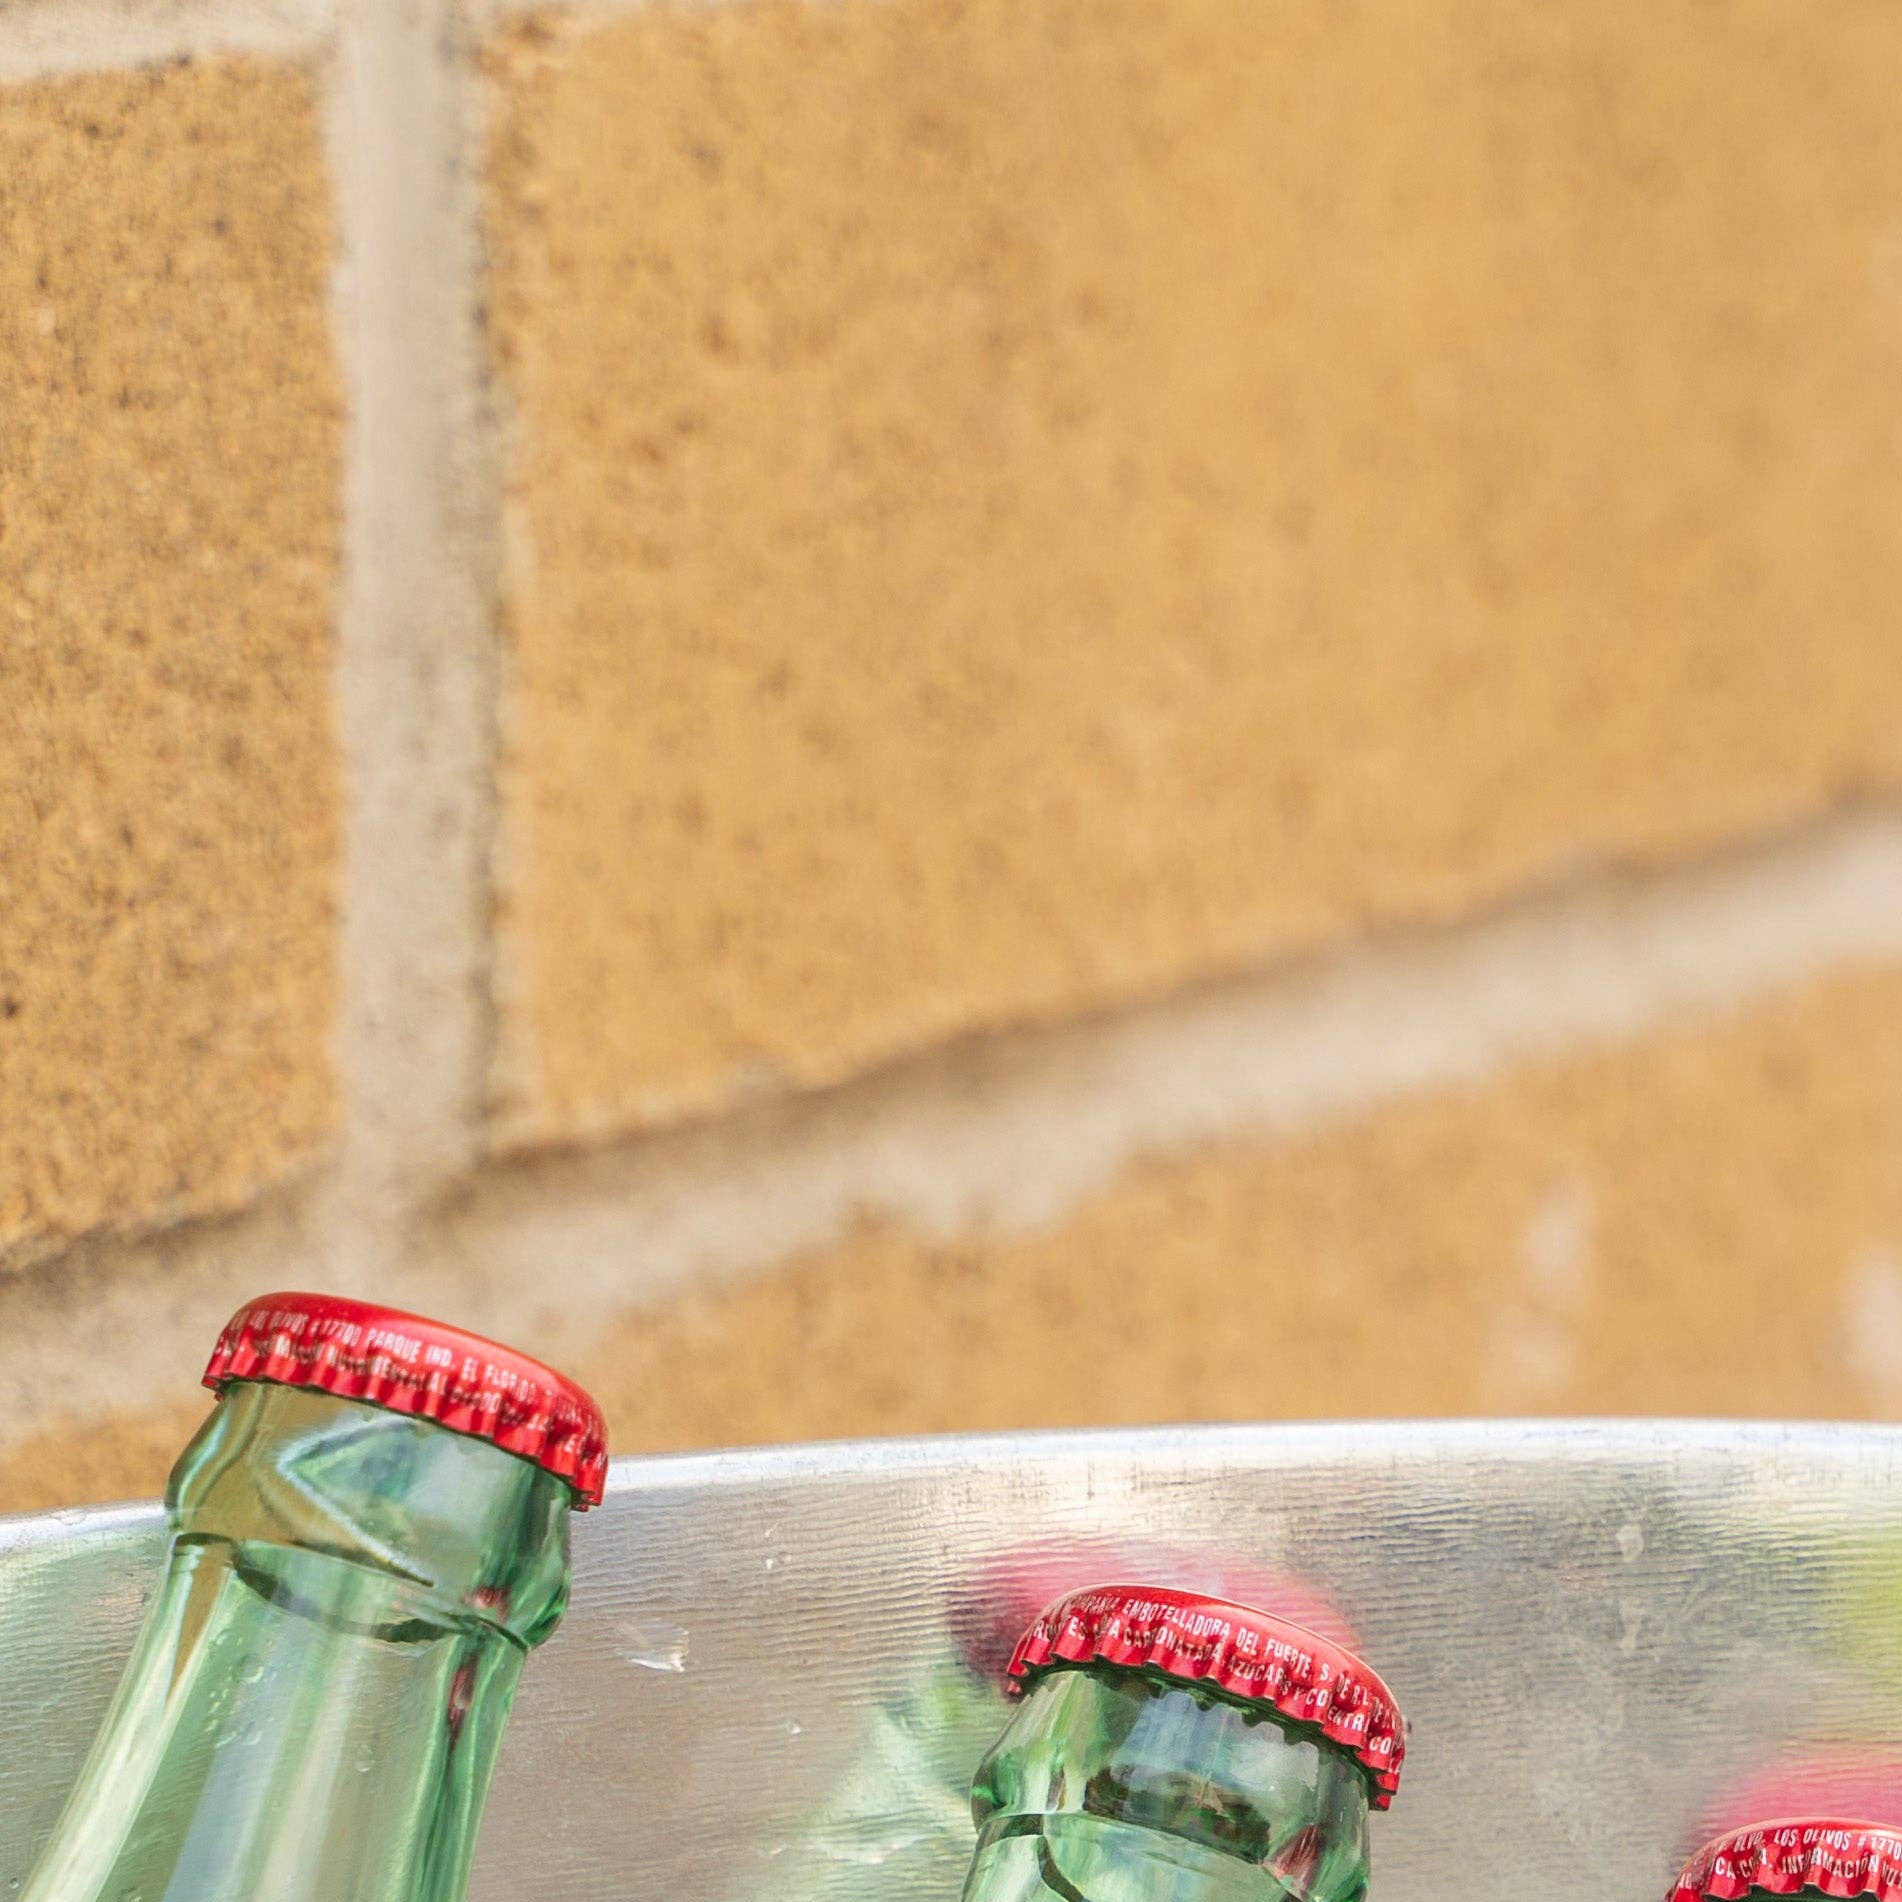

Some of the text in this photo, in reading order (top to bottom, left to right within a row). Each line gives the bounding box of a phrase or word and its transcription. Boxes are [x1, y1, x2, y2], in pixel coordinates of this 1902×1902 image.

[366, 1328, 422, 1364] PARQUE
[1122, 1599, 1231, 1640] EMBOTELLADORA
[1236, 1627, 1260, 1656] DEL
[1123, 1626, 1225, 1664] CARONATADA
[1227, 1655, 1292, 1696] AZÚCARS
[1774, 1829, 1799, 1847] LOS
[1803, 1829, 1852, 1851] OLIVOS
